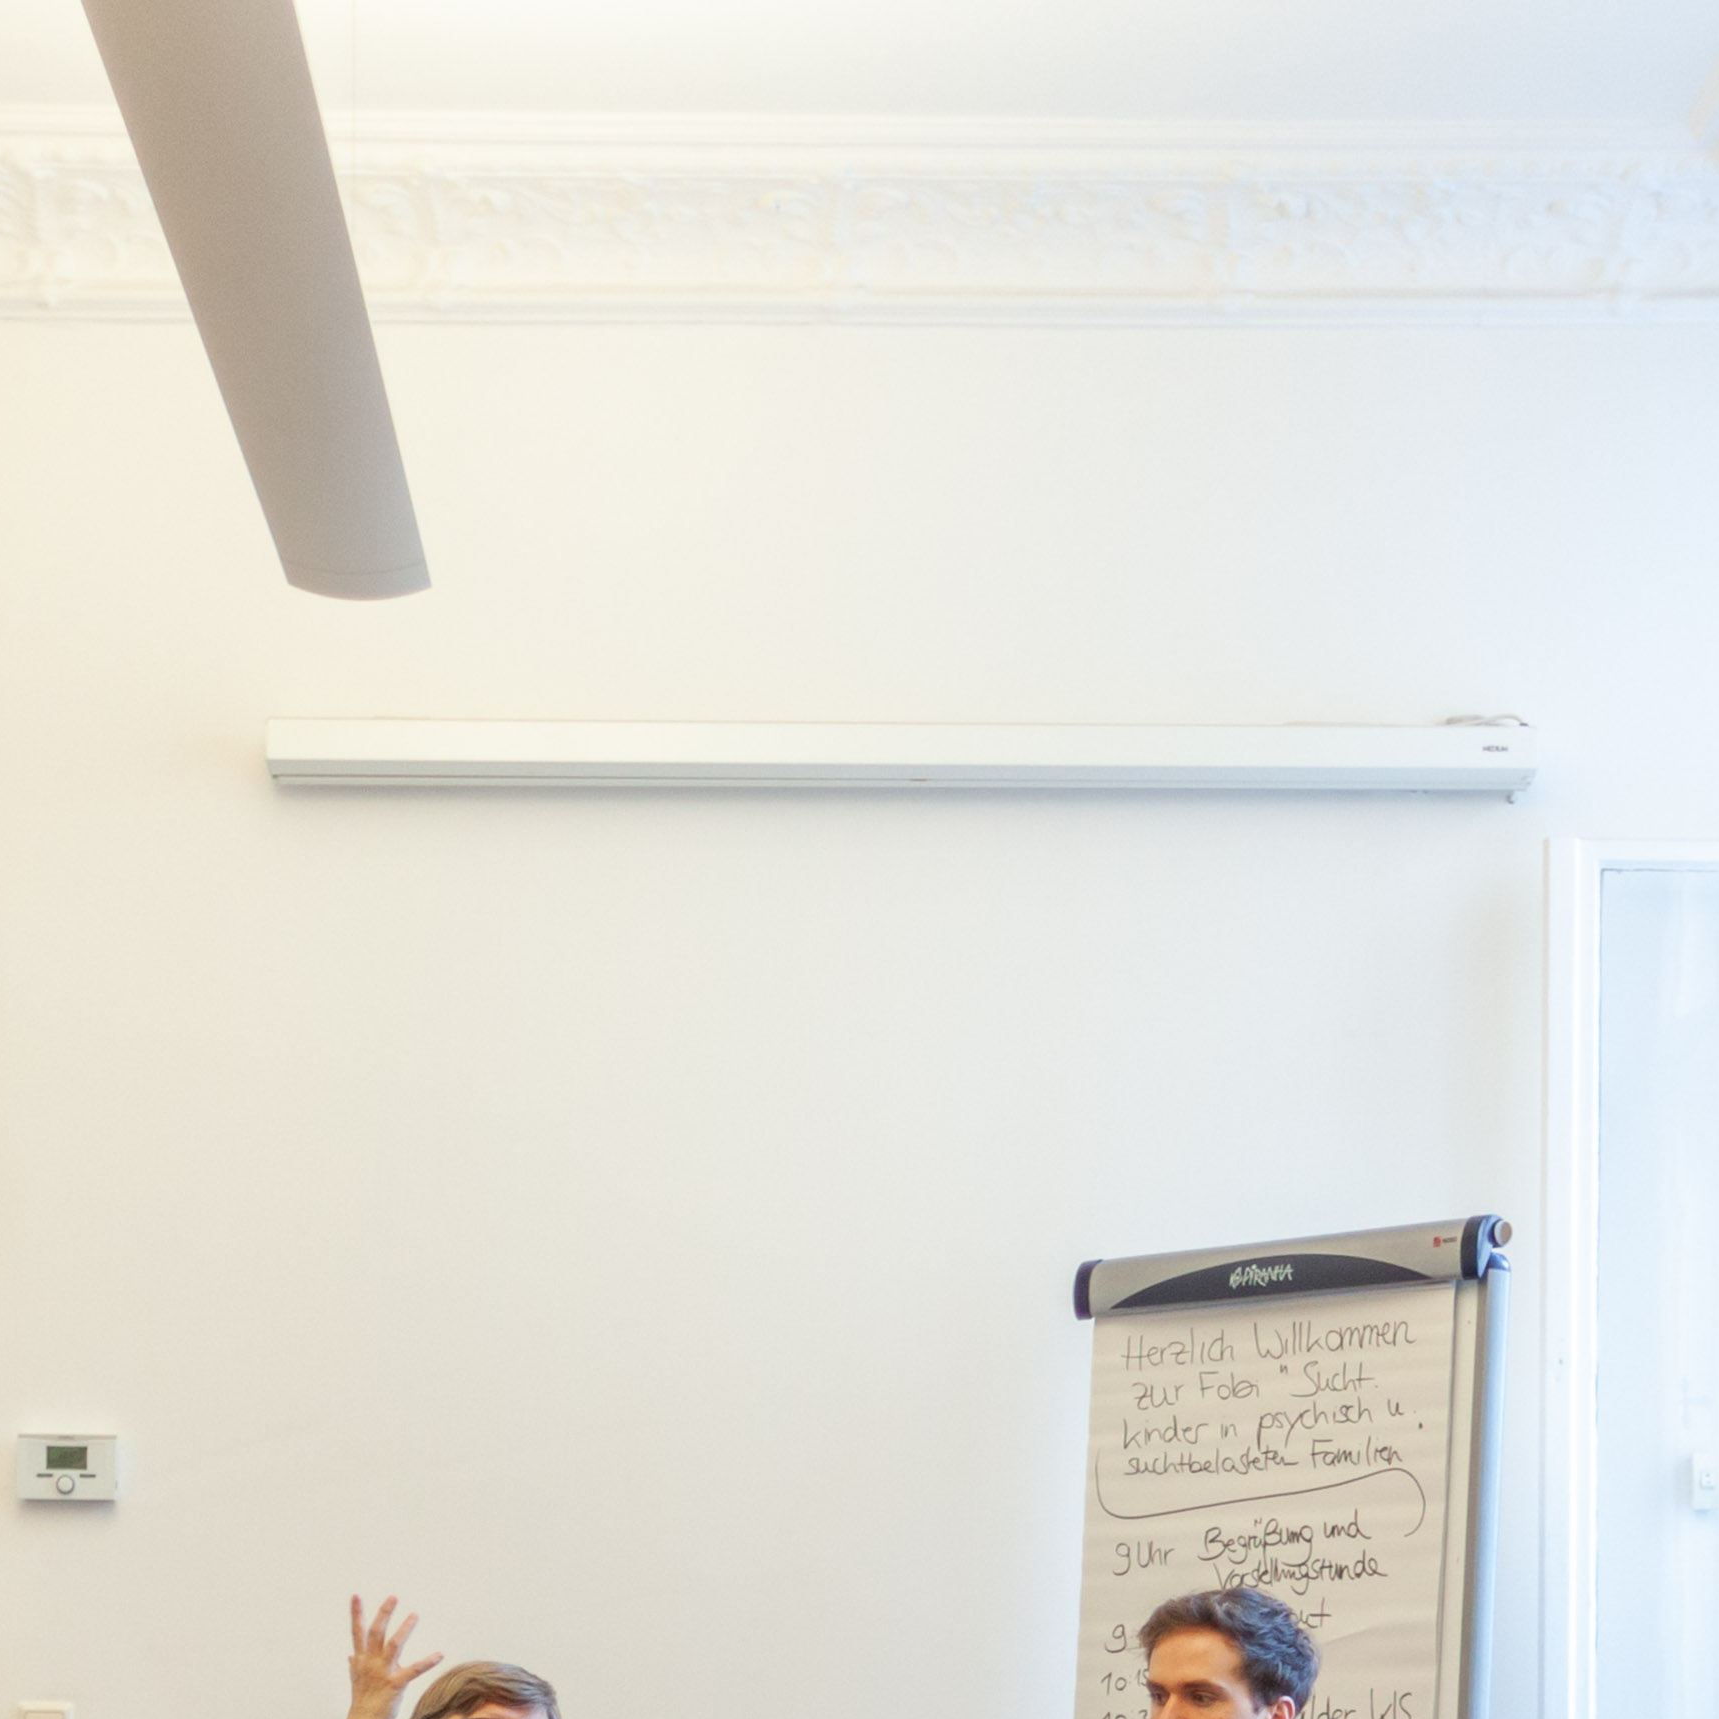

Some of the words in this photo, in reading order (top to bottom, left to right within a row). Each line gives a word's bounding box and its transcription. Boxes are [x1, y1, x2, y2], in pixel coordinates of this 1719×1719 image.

[1121, 1327, 1234, 1371] Herzlich
[1254, 1320, 1417, 1360] Willkommen
[1132, 1382, 1183, 1410] zur
[1199, 1371, 1259, 1400] Fobi
[1221, 1418, 1238, 1439] in
[1311, 1436, 1403, 1469] Familien
[1323, 1509, 1371, 1539] und
